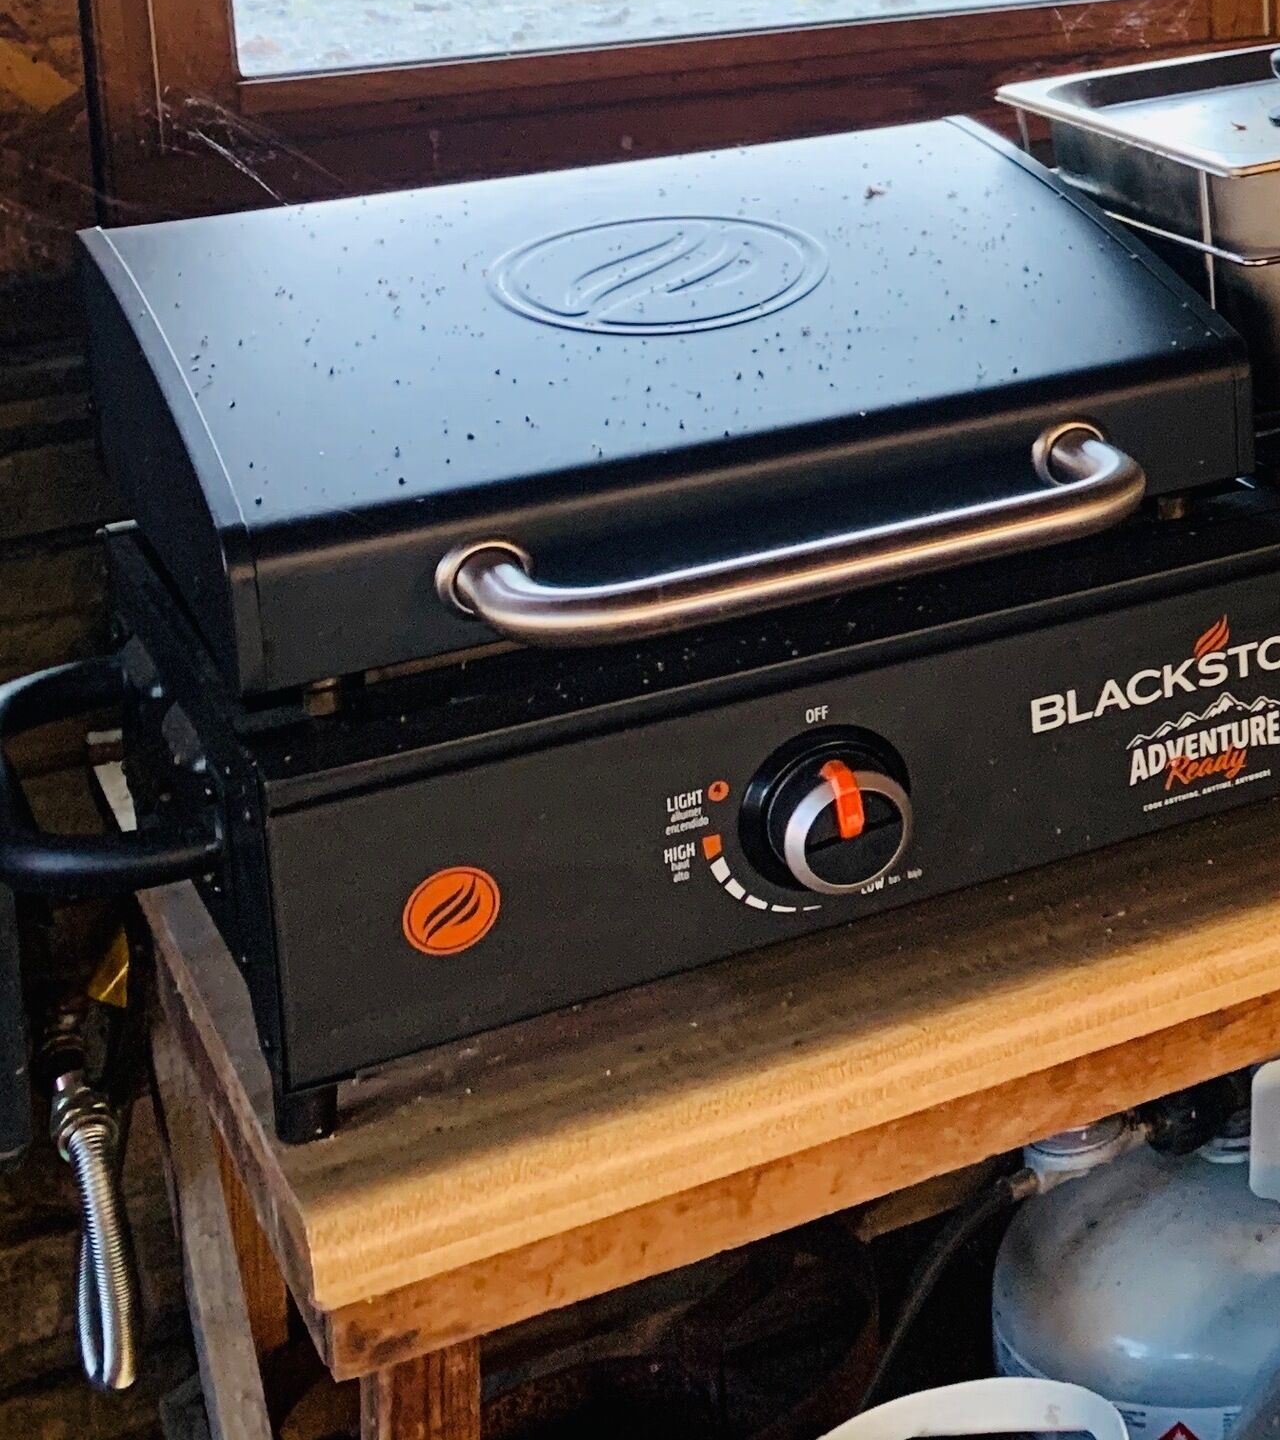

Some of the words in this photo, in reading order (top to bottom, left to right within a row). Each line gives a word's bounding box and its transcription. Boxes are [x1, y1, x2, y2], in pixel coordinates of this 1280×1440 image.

[805, 705, 829, 724] OFF
[1163, 742, 1248, 792] Ready
[666, 788, 703, 813] LIGHT
[663, 842, 696, 865] HIGH
